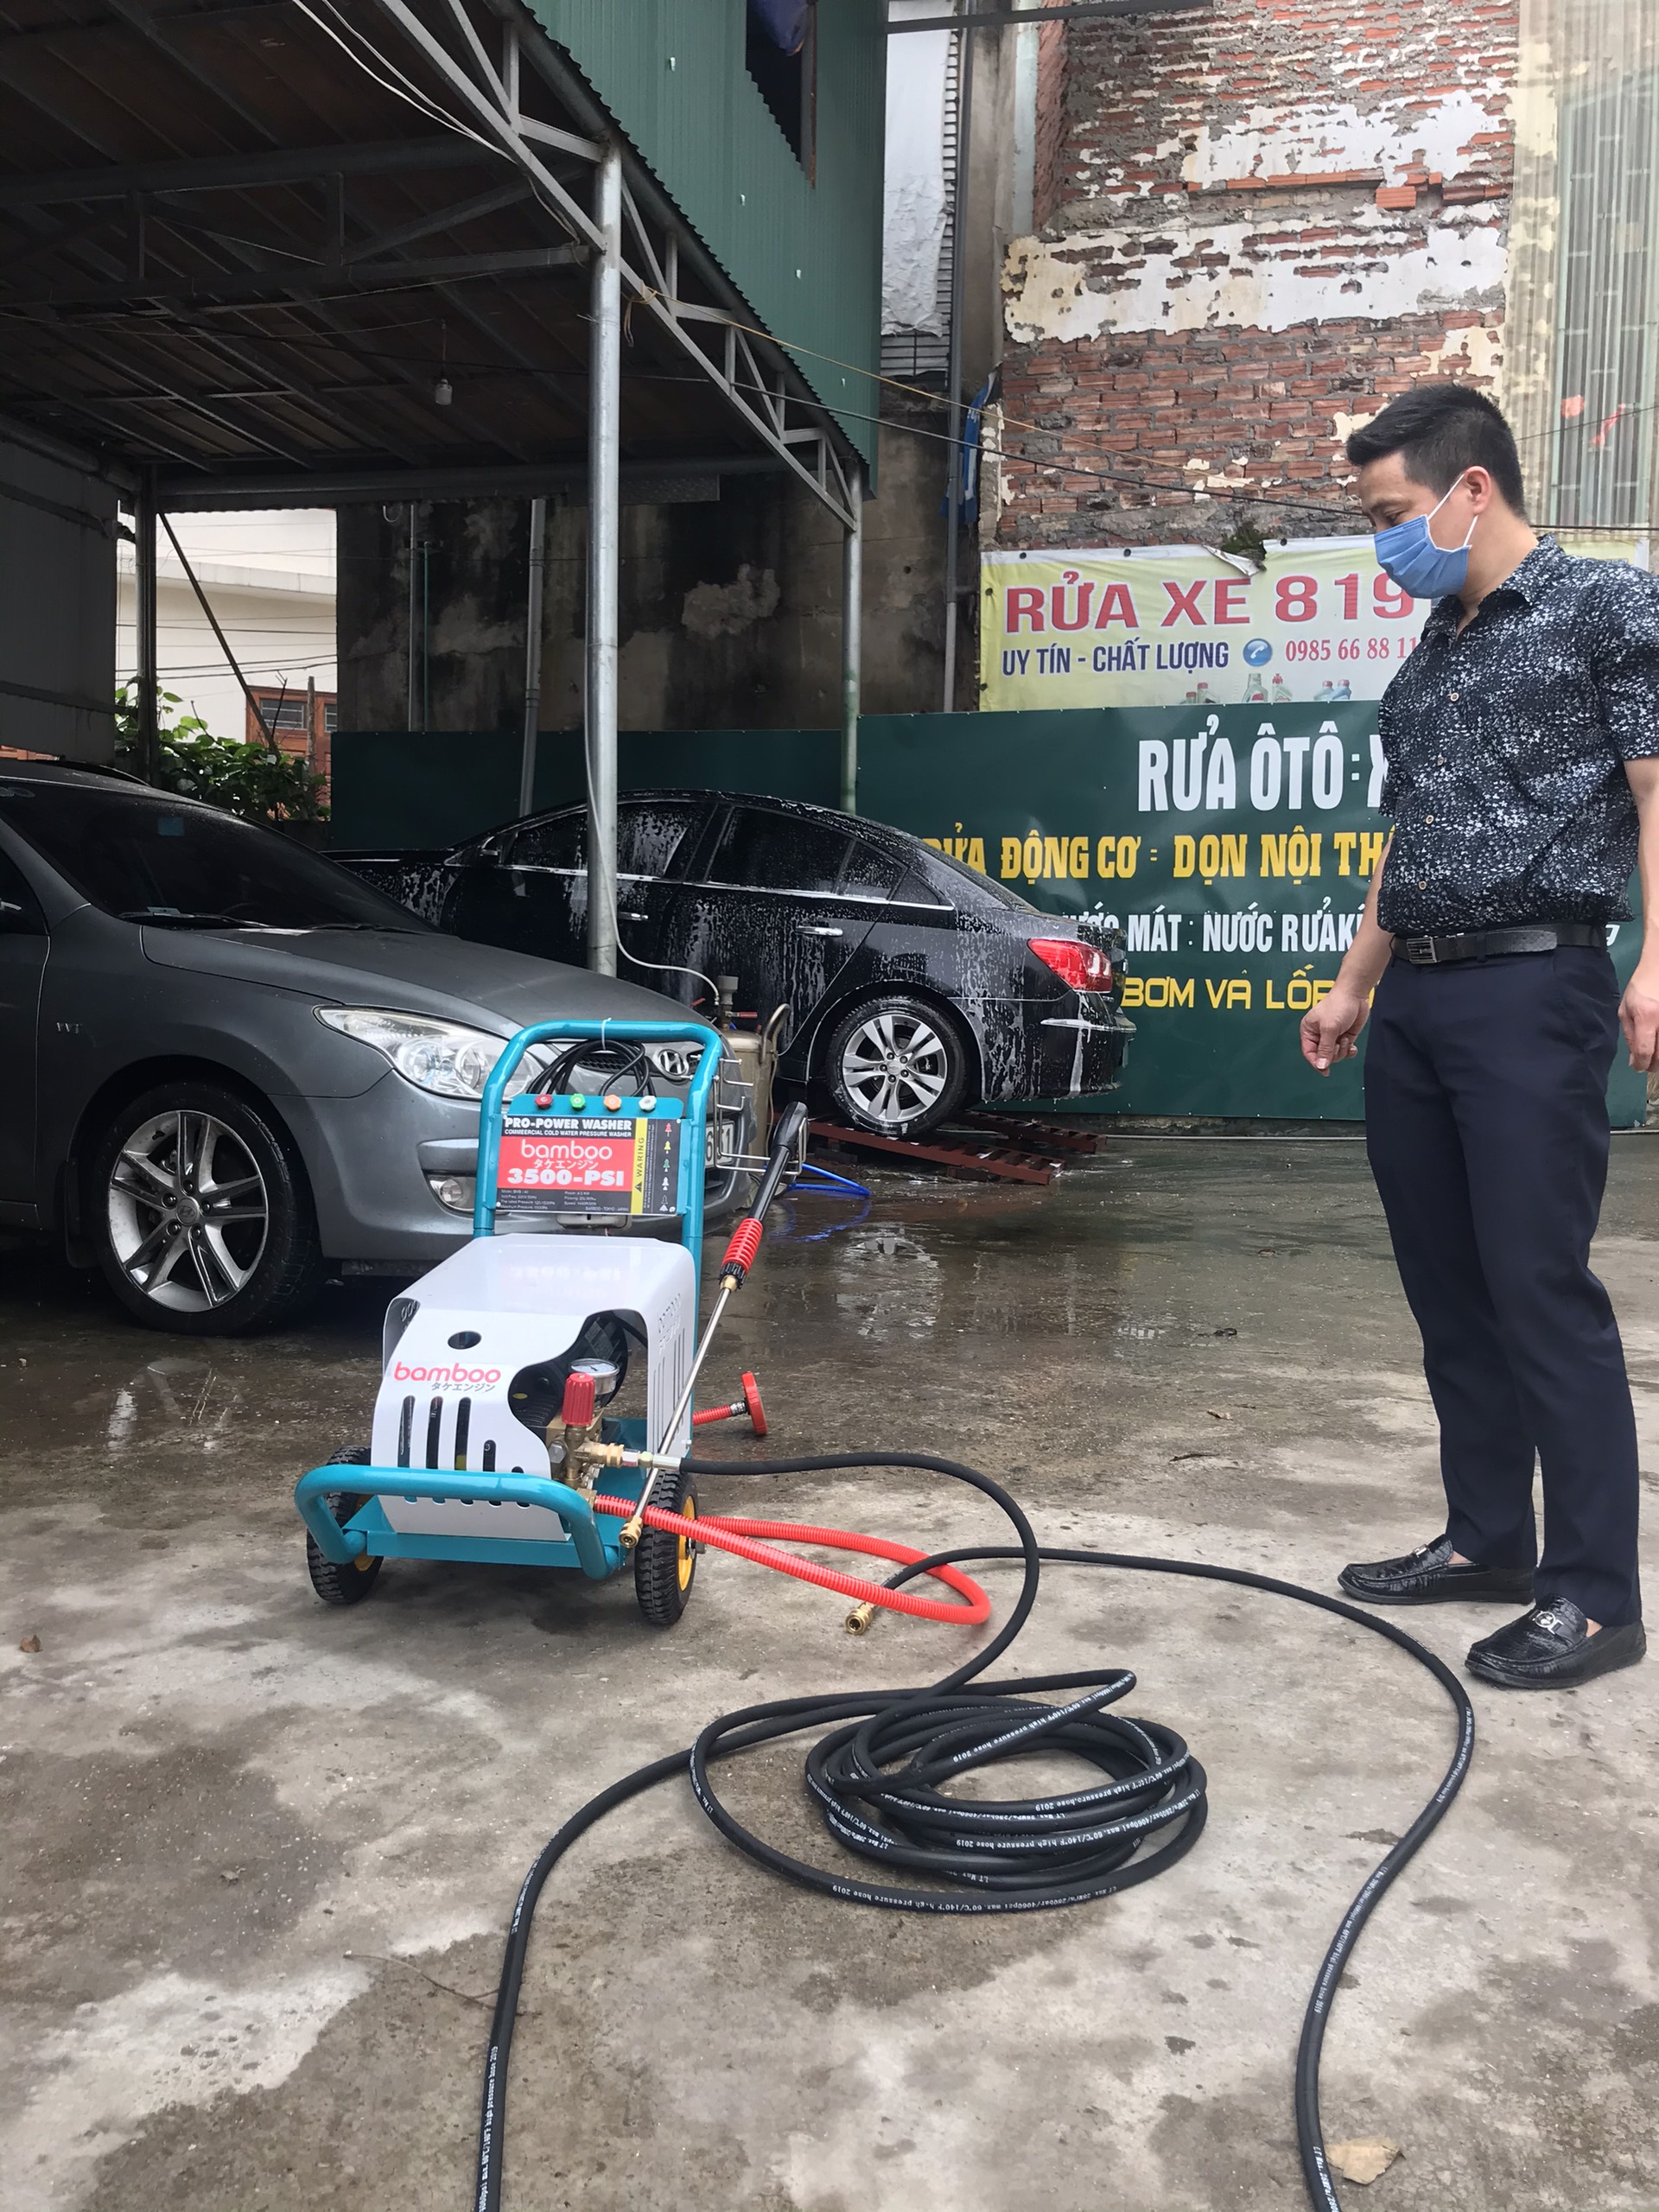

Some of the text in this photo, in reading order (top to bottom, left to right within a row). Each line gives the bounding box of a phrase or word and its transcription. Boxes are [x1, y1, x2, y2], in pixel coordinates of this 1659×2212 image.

[1007, 570, 1140, 633] RỬA
[1160, 577, 1251, 627] XE
[1002, 649, 1030, 676] UY
[1037, 643, 1071, 674] TÍN
[1092, 637, 1150, 672] CHẤT
[1156, 641, 1229, 674] LƯỢNG
[1285, 639, 1331, 662] 0985
[1338, 638, 1360, 660] 66
[1367, 637, 1389, 659] 88
[1000, 830, 1090, 885] ĐỘNG
[1097, 836, 1141, 879] CƠ
[1173, 833, 1248, 885] DỌN
[1260, 825, 1322, 885] NỘI
[1333, 825, 1395, 876] TH
[1128, 905, 1182, 952] MÁT
[1203, 901, 1274, 952] NƯỚC
[1121, 976, 1195, 1008] BƠM
[505, 1117, 632, 1131] PRO-POWER WASHER
[521, 1138, 613, 1160] bamboo
[636, 1137, 645, 1178] WARING
[533, 1159, 599, 1170] タケエンジン
[507, 1167, 625, 1187] 3500-PSI
[393, 1362, 501, 1383] bamboo
[431, 1382, 495, 1393] タケエンジン
[956, 1839, 974, 1847] 2019
[832, 1885, 851, 1896] 2019
[853, 1891, 872, 1901] hose
[874, 1895, 912, 1907] pressure
